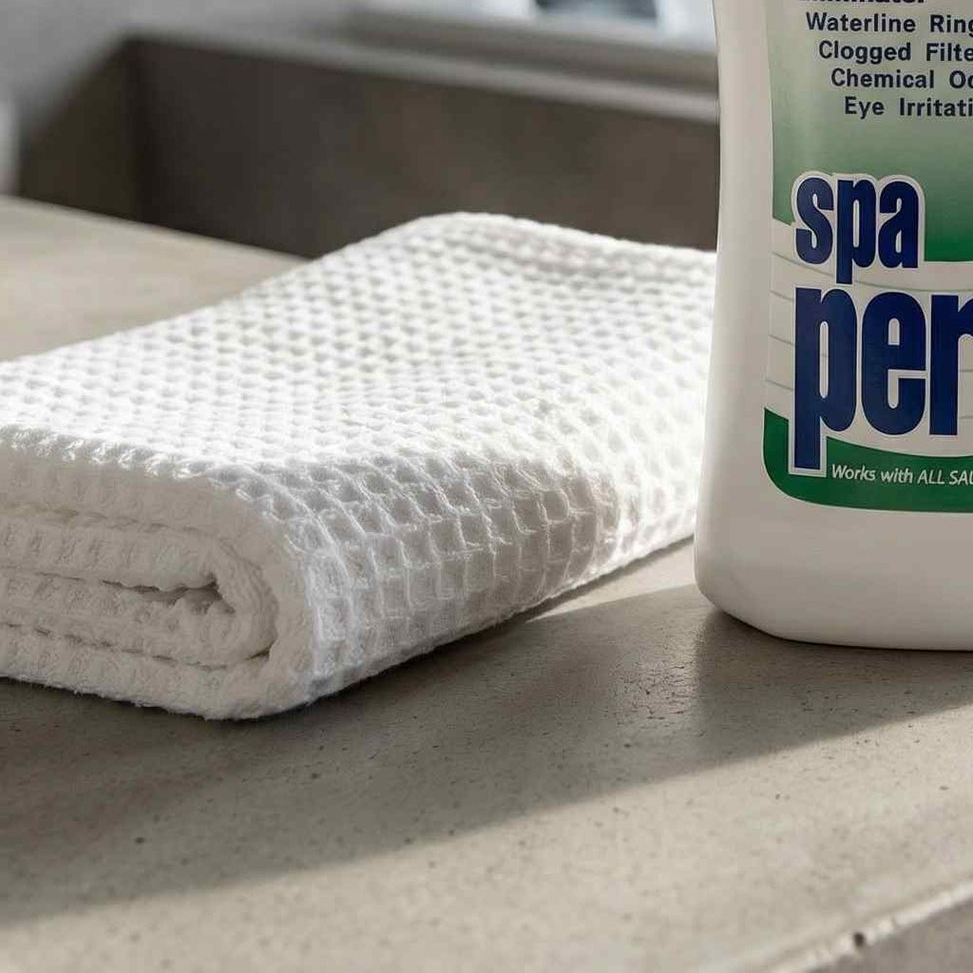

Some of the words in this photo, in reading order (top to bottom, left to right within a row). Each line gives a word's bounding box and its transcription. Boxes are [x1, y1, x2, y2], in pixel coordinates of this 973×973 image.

[806, 12, 916, 33] Waterline
[818, 40, 911, 64] Clogged
[831, 68, 934, 89] Chemical
[844, 96, 885, 119] Eye
[795, 176, 920, 285] spa
[831, 464, 876, 481] Works
[880, 468, 914, 484] with
[917, 469, 946, 485] ALL
